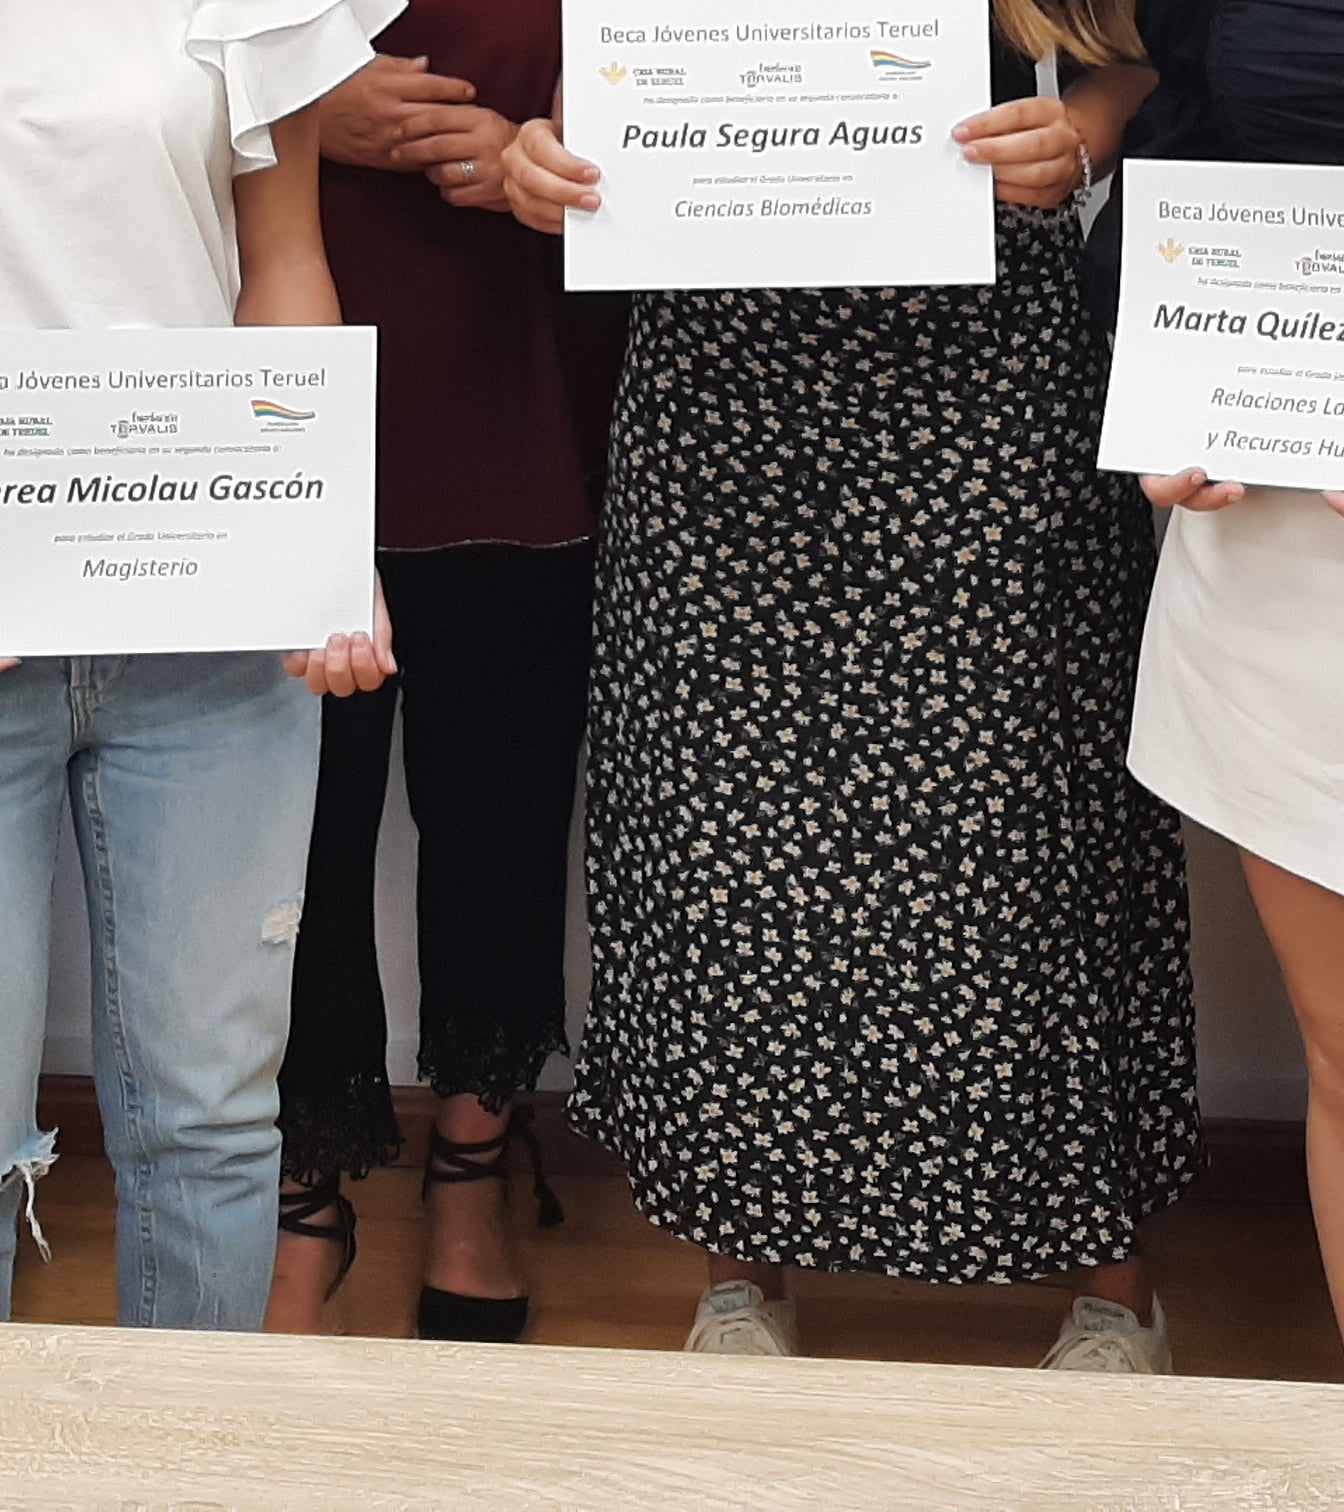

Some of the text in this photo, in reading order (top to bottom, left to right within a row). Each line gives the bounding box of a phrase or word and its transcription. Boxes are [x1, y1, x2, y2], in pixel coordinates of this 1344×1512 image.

[601, 19, 939, 44] Beca Jóvenes Universitarios Teruel
[622, 121, 924, 153] Paula Segura Aguas
[674, 193, 872, 217] Ciencias Biomédicas
[1158, 201, 1202, 221] Beca
[1208, 202, 1285, 226] Jóvenes
[1153, 304, 1247, 334] Marta
[16, 368, 101, 390] Jóvenes
[108, 368, 253, 390] Universitarios
[259, 368, 326, 388] Teruel
[1211, 387, 1317, 414] Relaciones
[1206, 431, 1219, 451] y
[1224, 429, 1311, 456] Recursos
[67, 475, 198, 503] Micolau
[209, 472, 323, 501] Gascón
[82, 557, 198, 580] Magisterio
